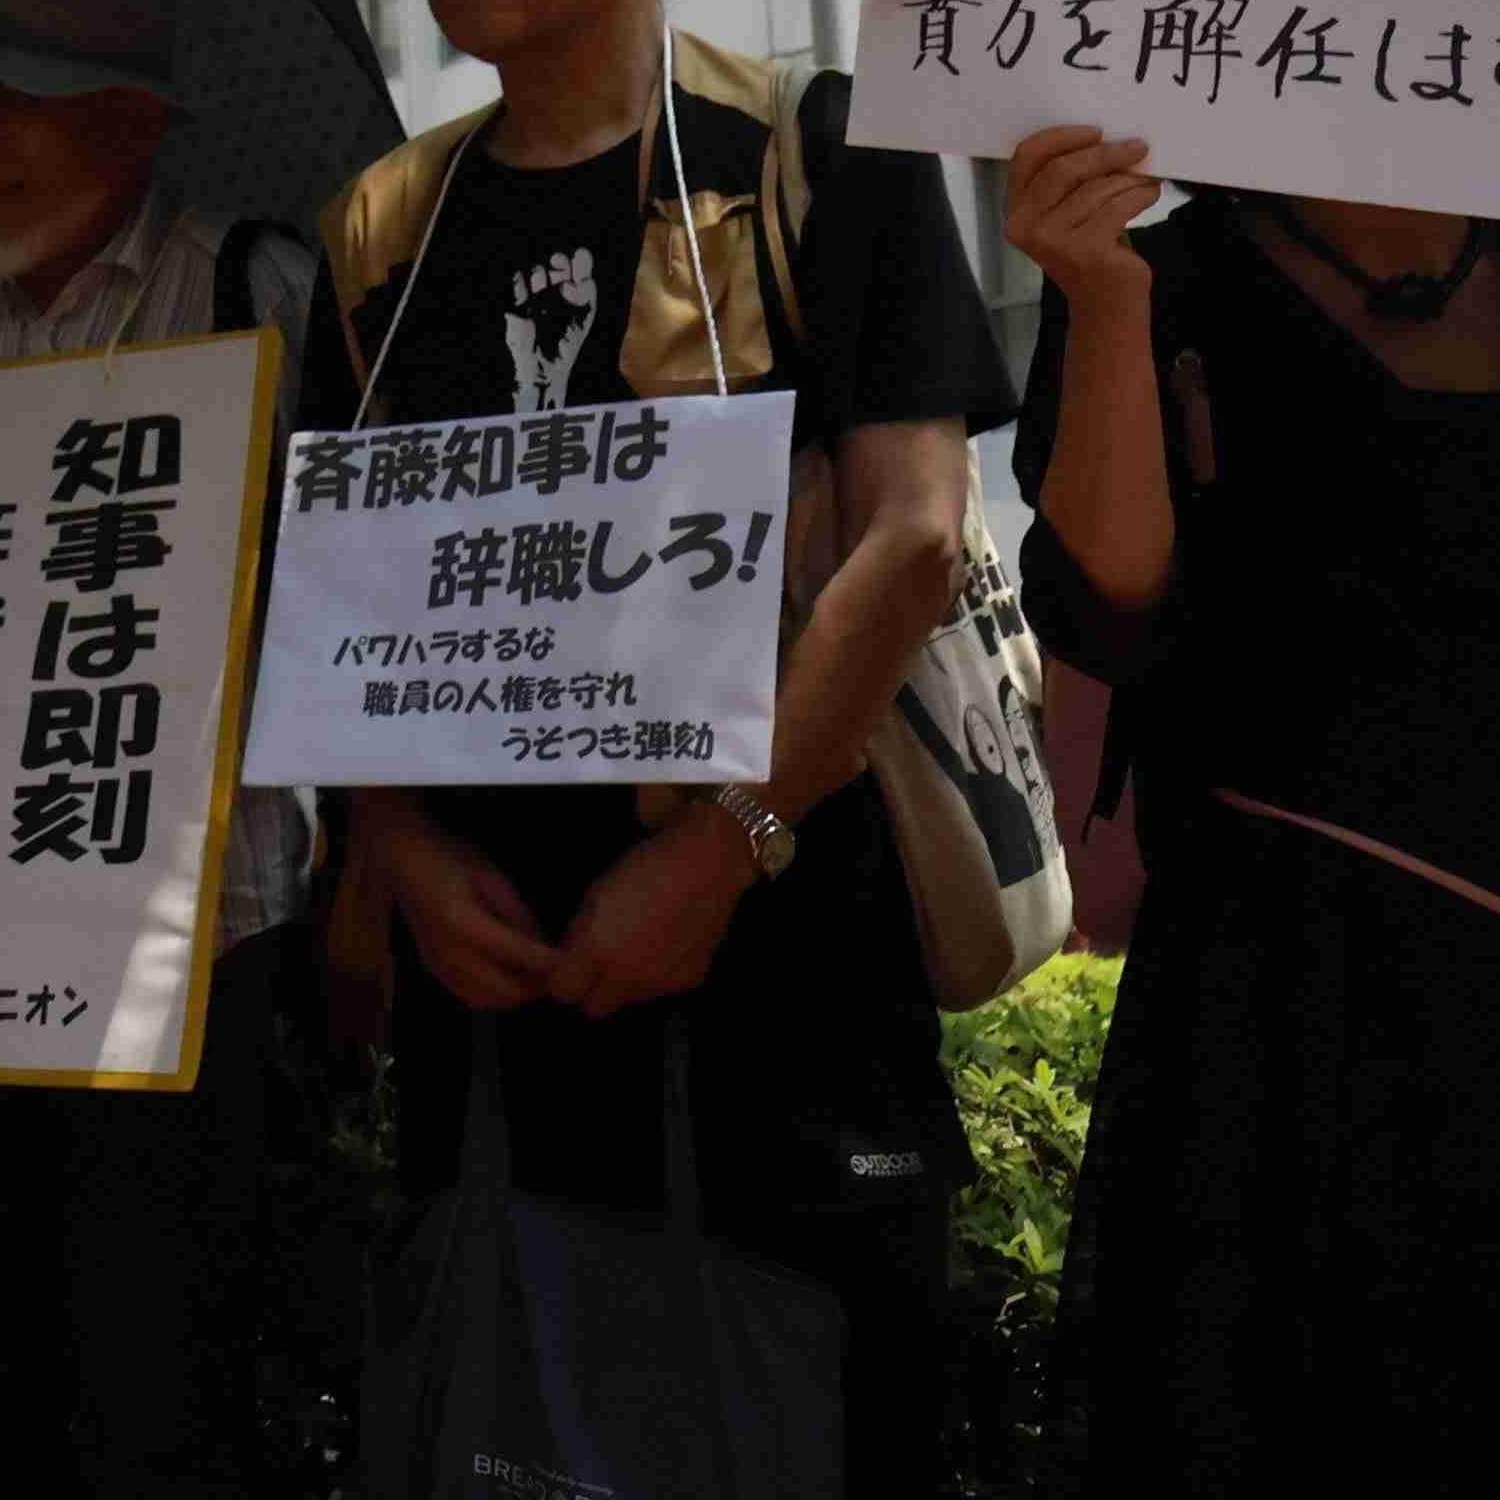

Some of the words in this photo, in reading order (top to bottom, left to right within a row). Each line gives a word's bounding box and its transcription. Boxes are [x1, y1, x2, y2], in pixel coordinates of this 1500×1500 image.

[294, 406, 671, 513] 斉藤知事は
[427, 512, 773, 609] 辞職しろ!
[9, 414, 182, 866] 知事は即刻
[332, 625, 556, 668] パワハラするな
[362, 671, 638, 718] 職員の人権を守れ
